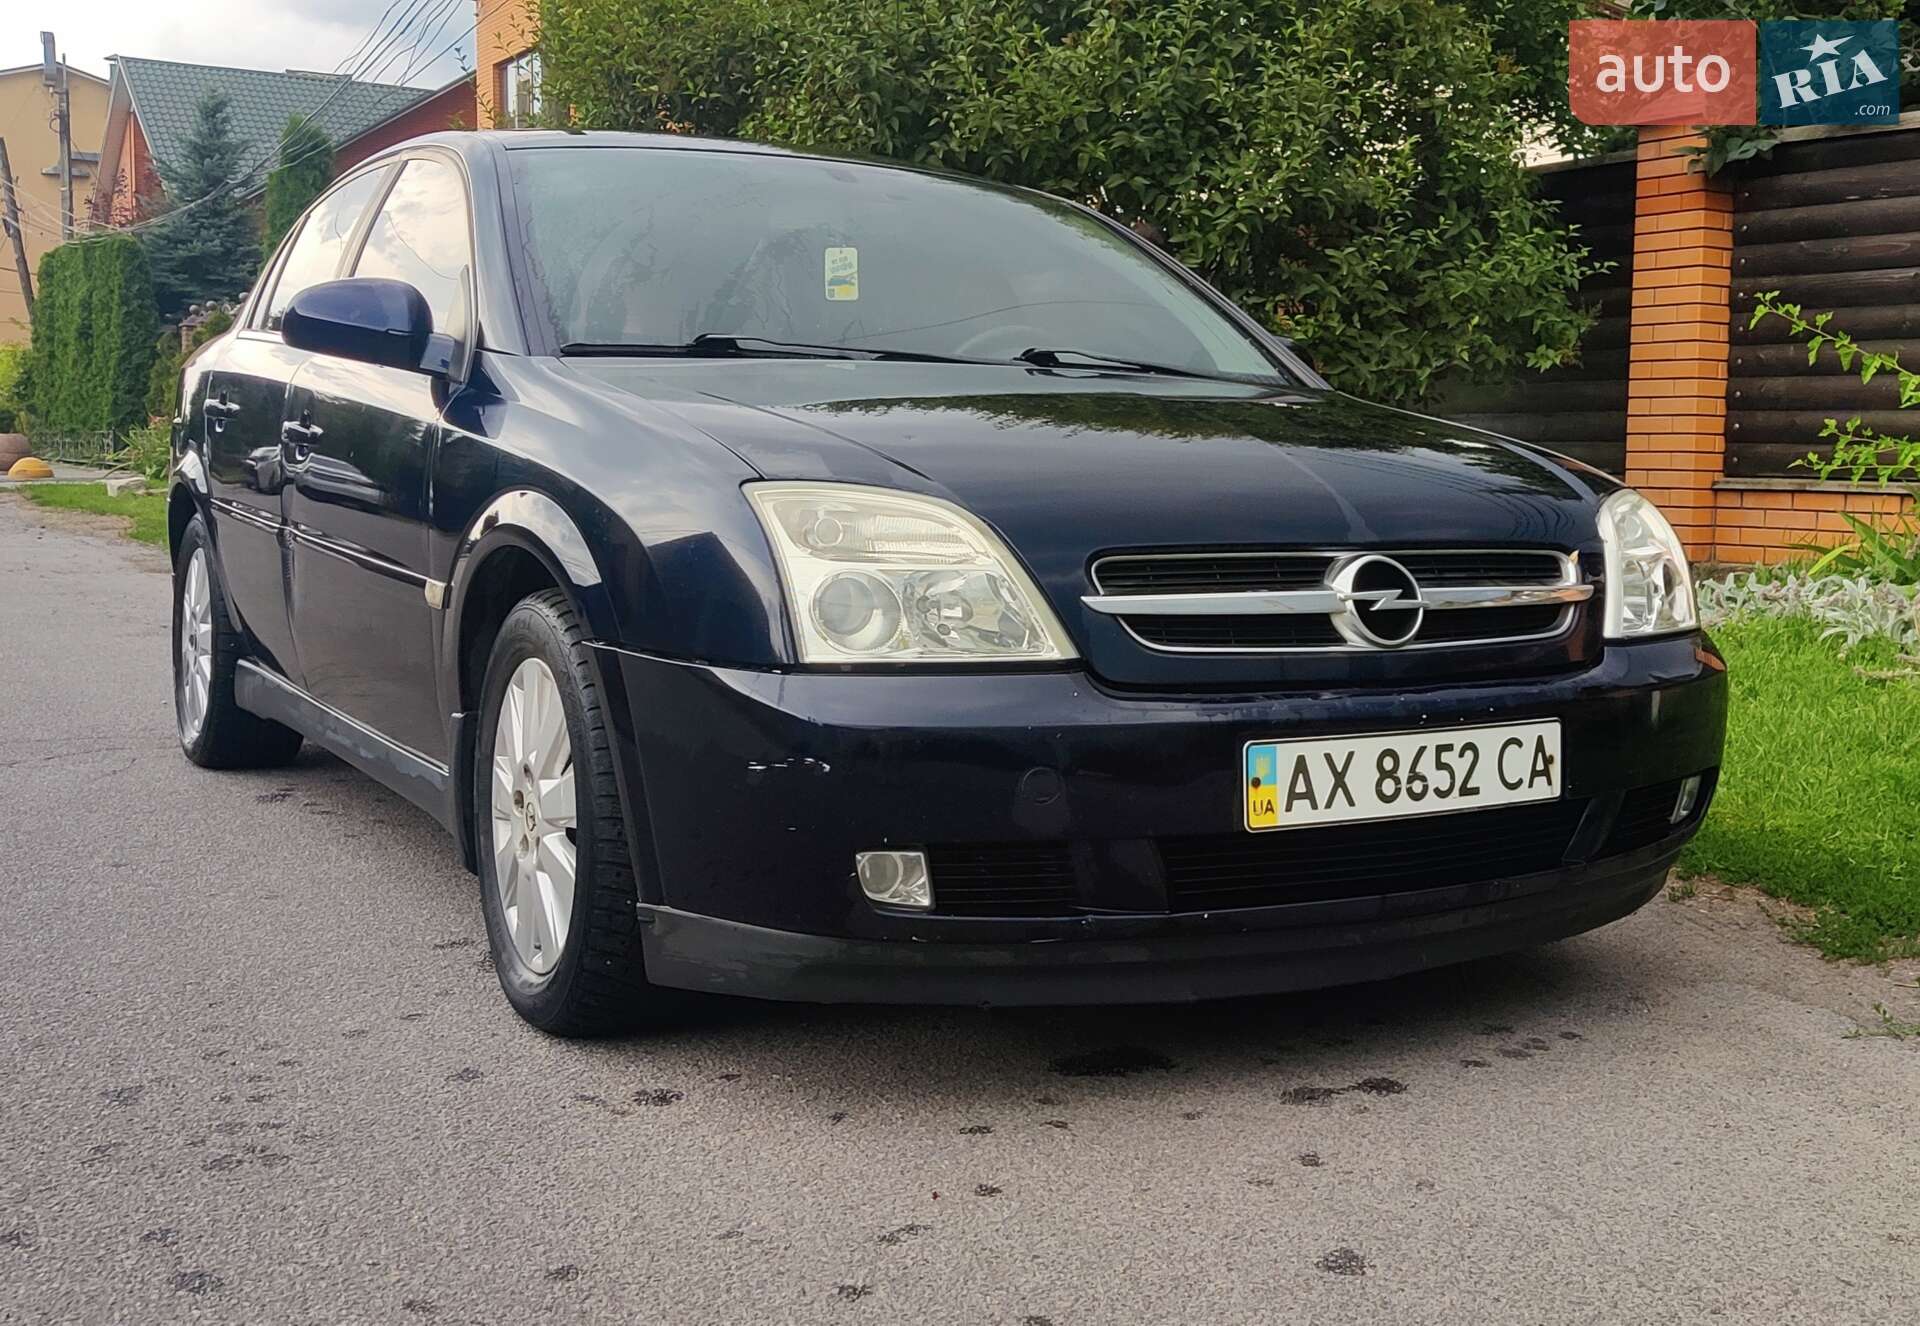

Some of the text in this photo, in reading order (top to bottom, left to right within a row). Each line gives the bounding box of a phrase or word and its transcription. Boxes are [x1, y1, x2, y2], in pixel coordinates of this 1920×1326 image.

[1284, 734, 1553, 813] AX 8652 CA
[1252, 799, 1275, 817] UA
